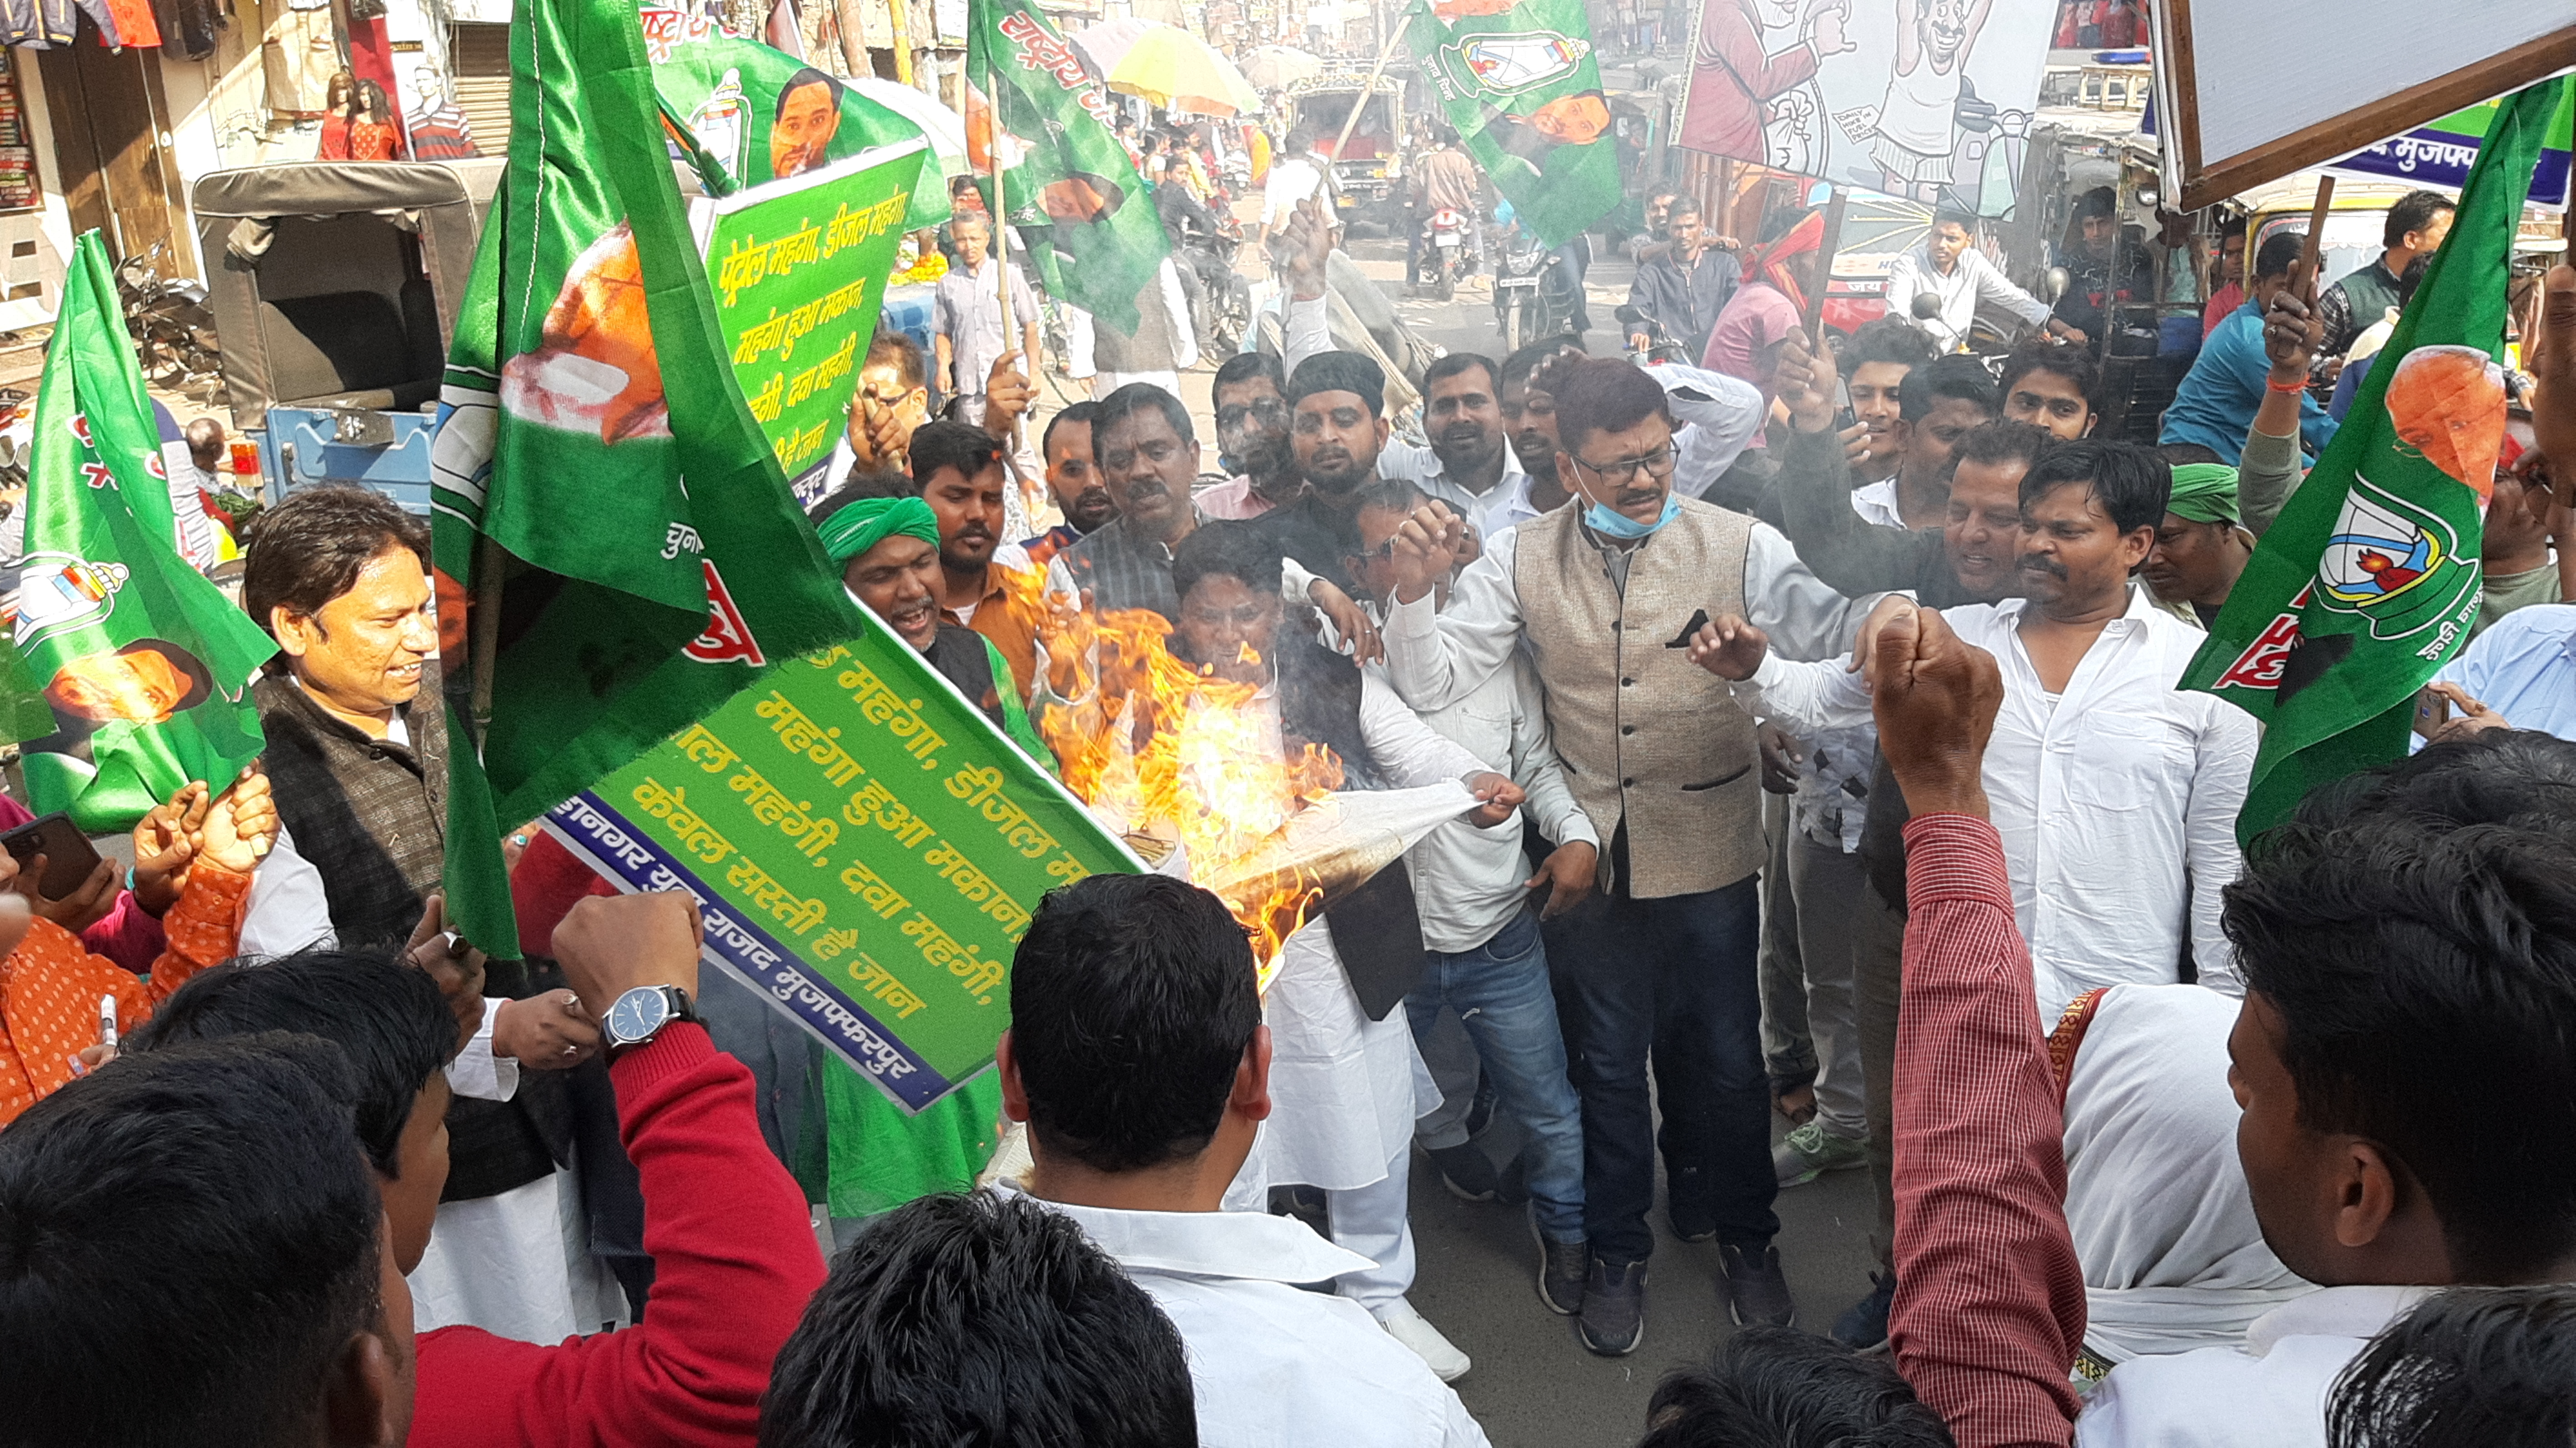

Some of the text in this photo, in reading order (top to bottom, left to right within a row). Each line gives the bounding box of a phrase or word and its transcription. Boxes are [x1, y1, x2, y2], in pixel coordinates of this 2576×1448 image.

[1837, 110, 1862, 121] DAILY
[1842, 117, 1861, 128] HIKE
[1848, 123, 1867, 135] FUEL
[823, 202, 873, 259] डीजल
[1846, 282, 1882, 292] जय
[734, 307, 790, 365] महंगा
[781, 298, 824, 361] हुआ
[787, 366, 818, 407] दवा
[796, 419, 829, 462] जान
[755, 689, 865, 788] महंगा
[843, 778, 937, 849] हुआ
[838, 659, 1062, 858] महंगा, डीजल
[633, 776, 928, 1019] केवल सस्ती है जान
[729, 764, 840, 867] महंगी,
[841, 859, 911, 919] दवा
[901, 911, 1005, 1005] महंगी,
[703, 908, 782, 970] राजद
